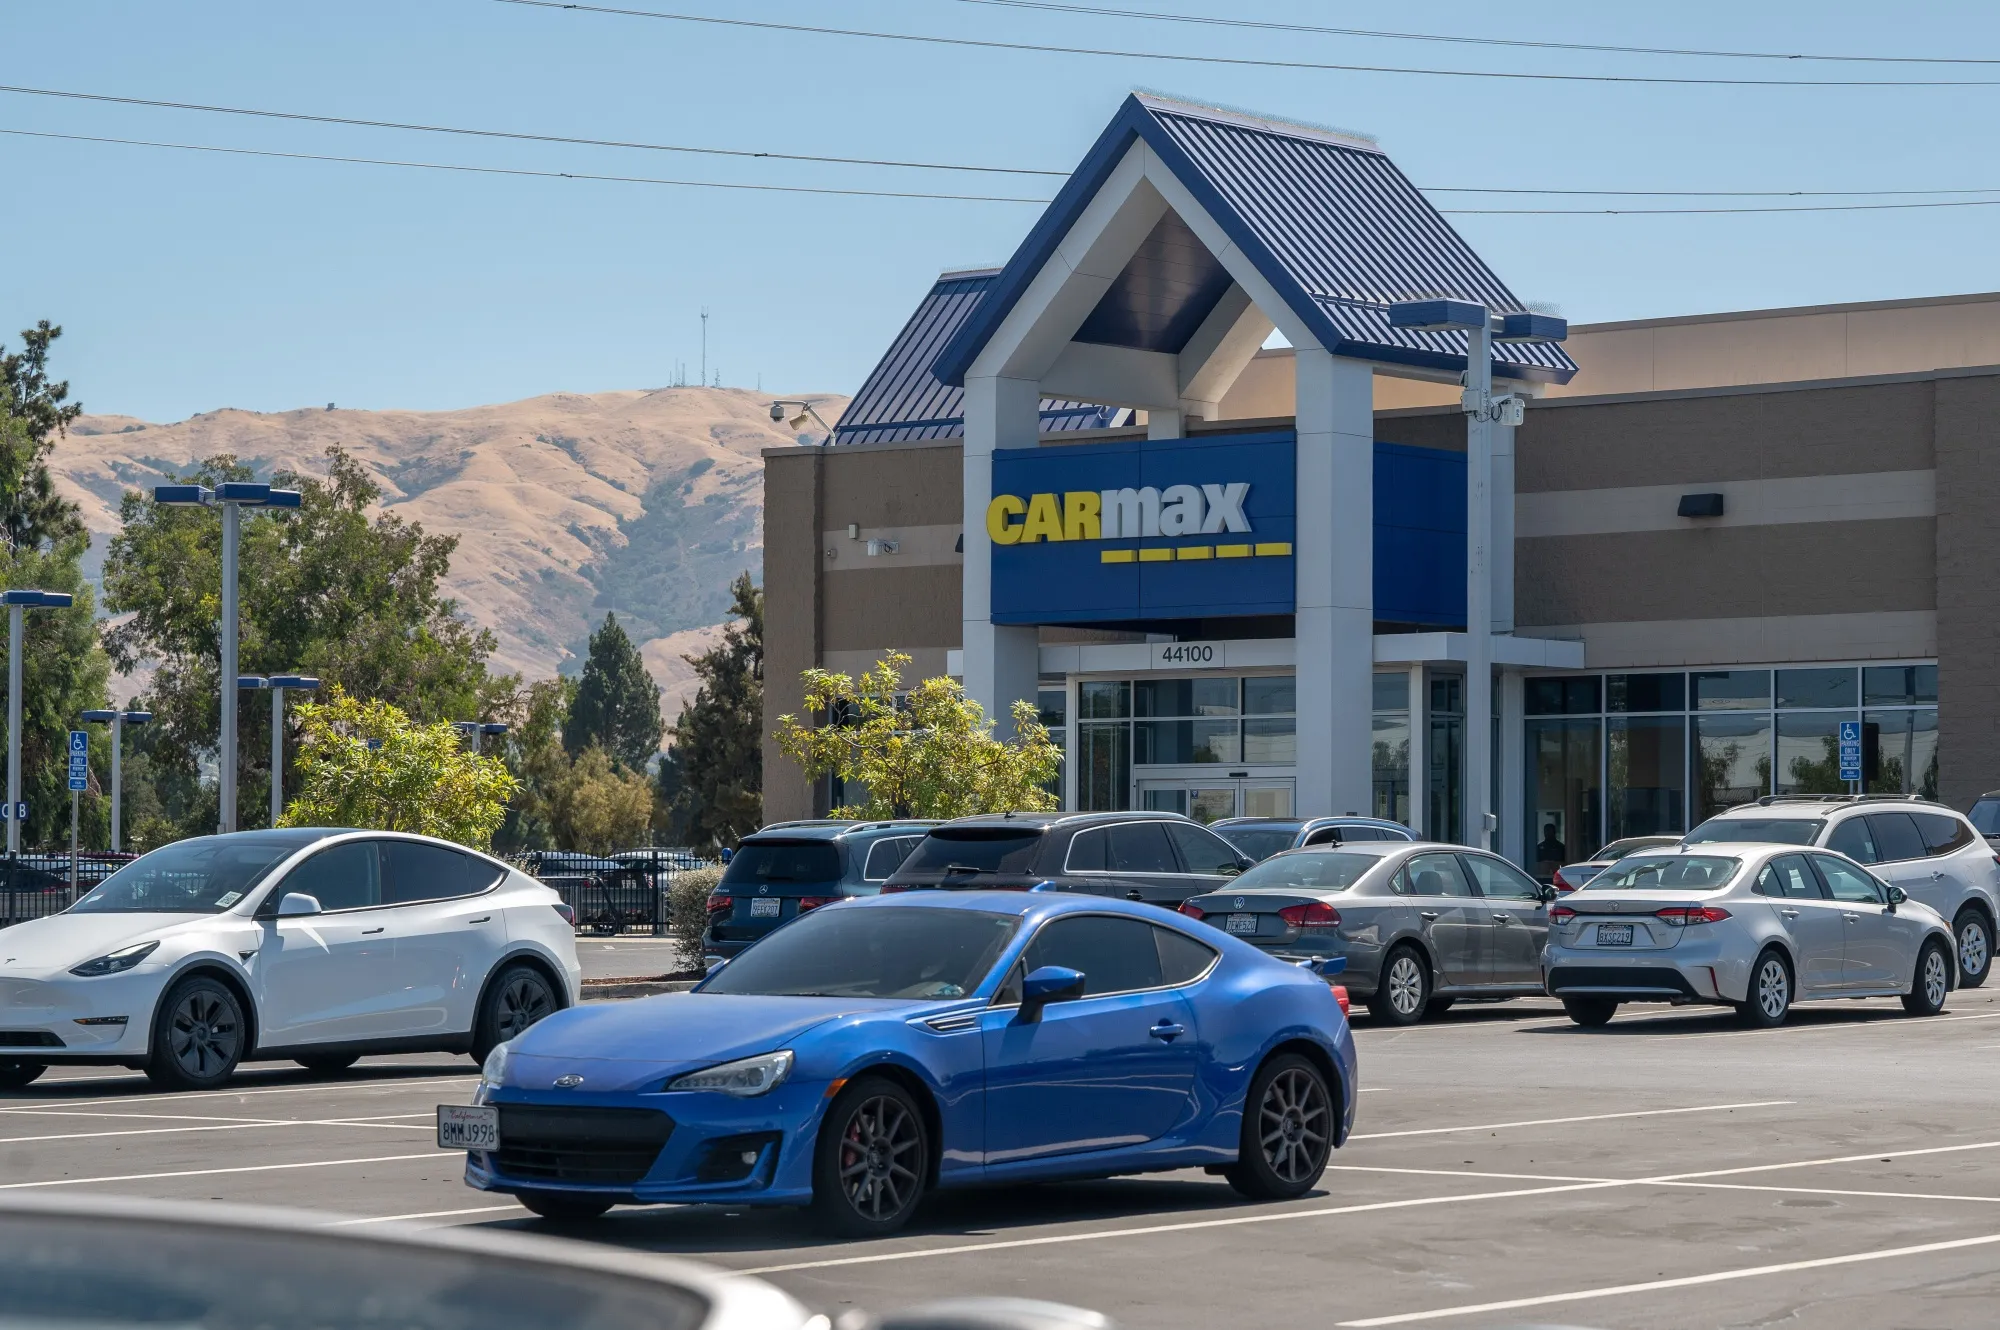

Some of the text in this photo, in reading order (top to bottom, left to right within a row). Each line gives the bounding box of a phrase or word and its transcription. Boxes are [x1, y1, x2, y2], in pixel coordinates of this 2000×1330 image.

[1162, 645, 1213, 662] 44100
[19, 803, 26, 818] B
[1599, 932, 1630, 943] 8XSC219
[443, 1121, 495, 1143] 8MMJ998
